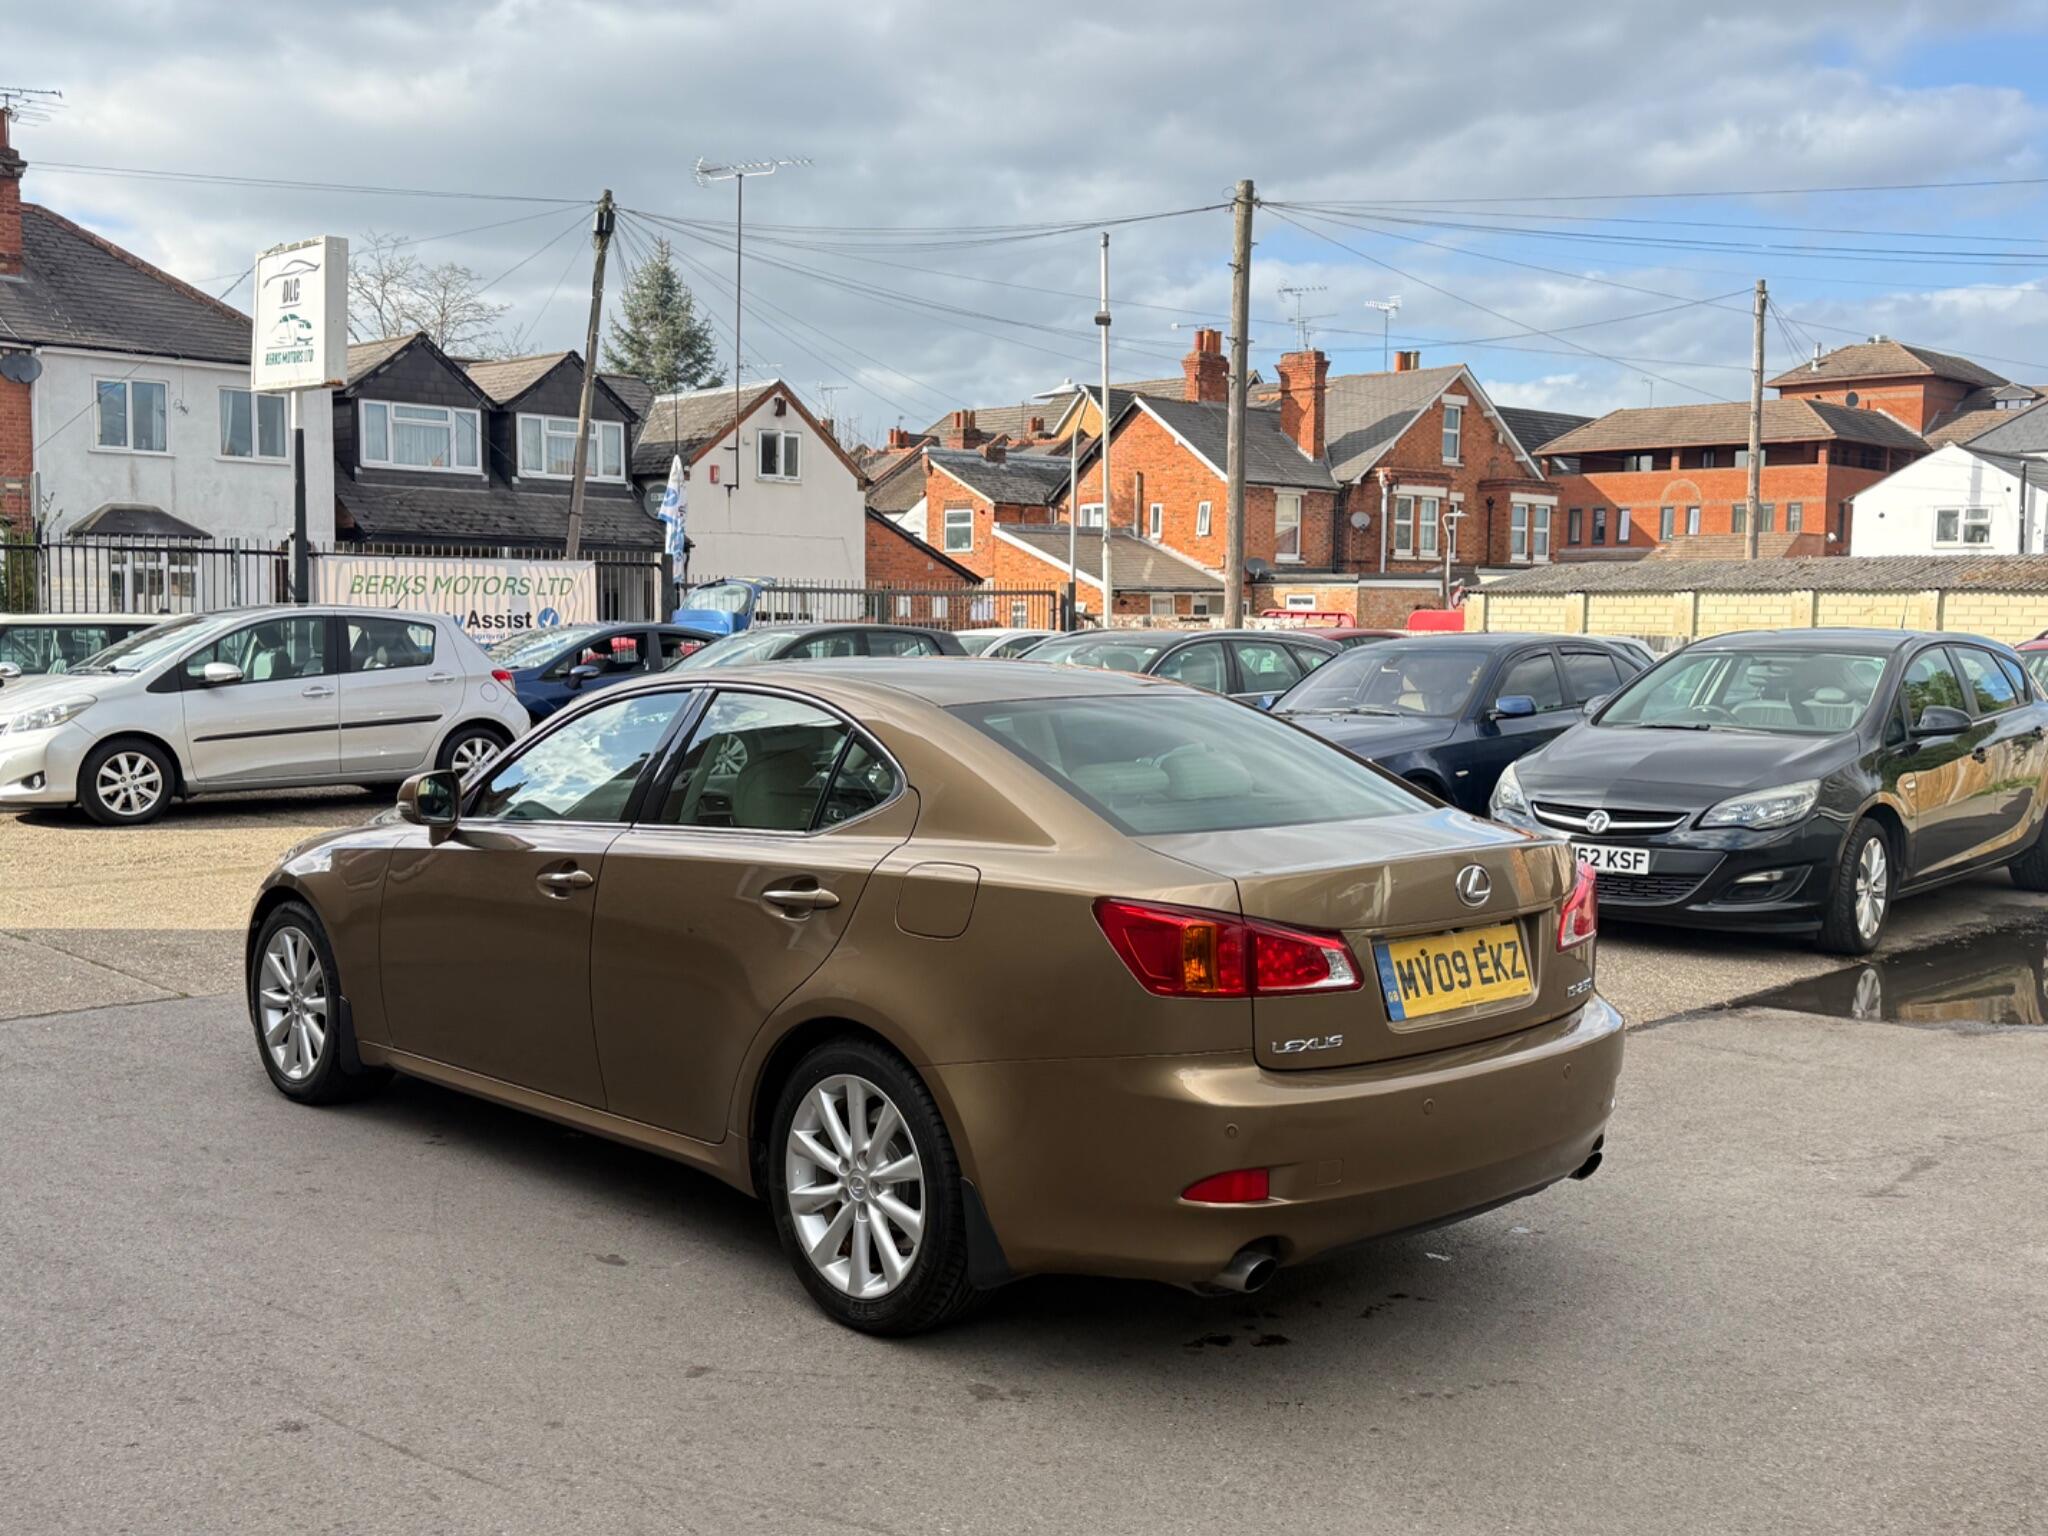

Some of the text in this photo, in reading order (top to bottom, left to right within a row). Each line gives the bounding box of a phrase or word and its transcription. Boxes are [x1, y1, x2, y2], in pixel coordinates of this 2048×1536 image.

[350, 575, 575, 596] BERKS MOTORS LTD
[1606, 849, 1646, 871] KSF
[1396, 940, 1526, 1001] MV09 EKZ
[1271, 1034, 1344, 1054] LEXUS
